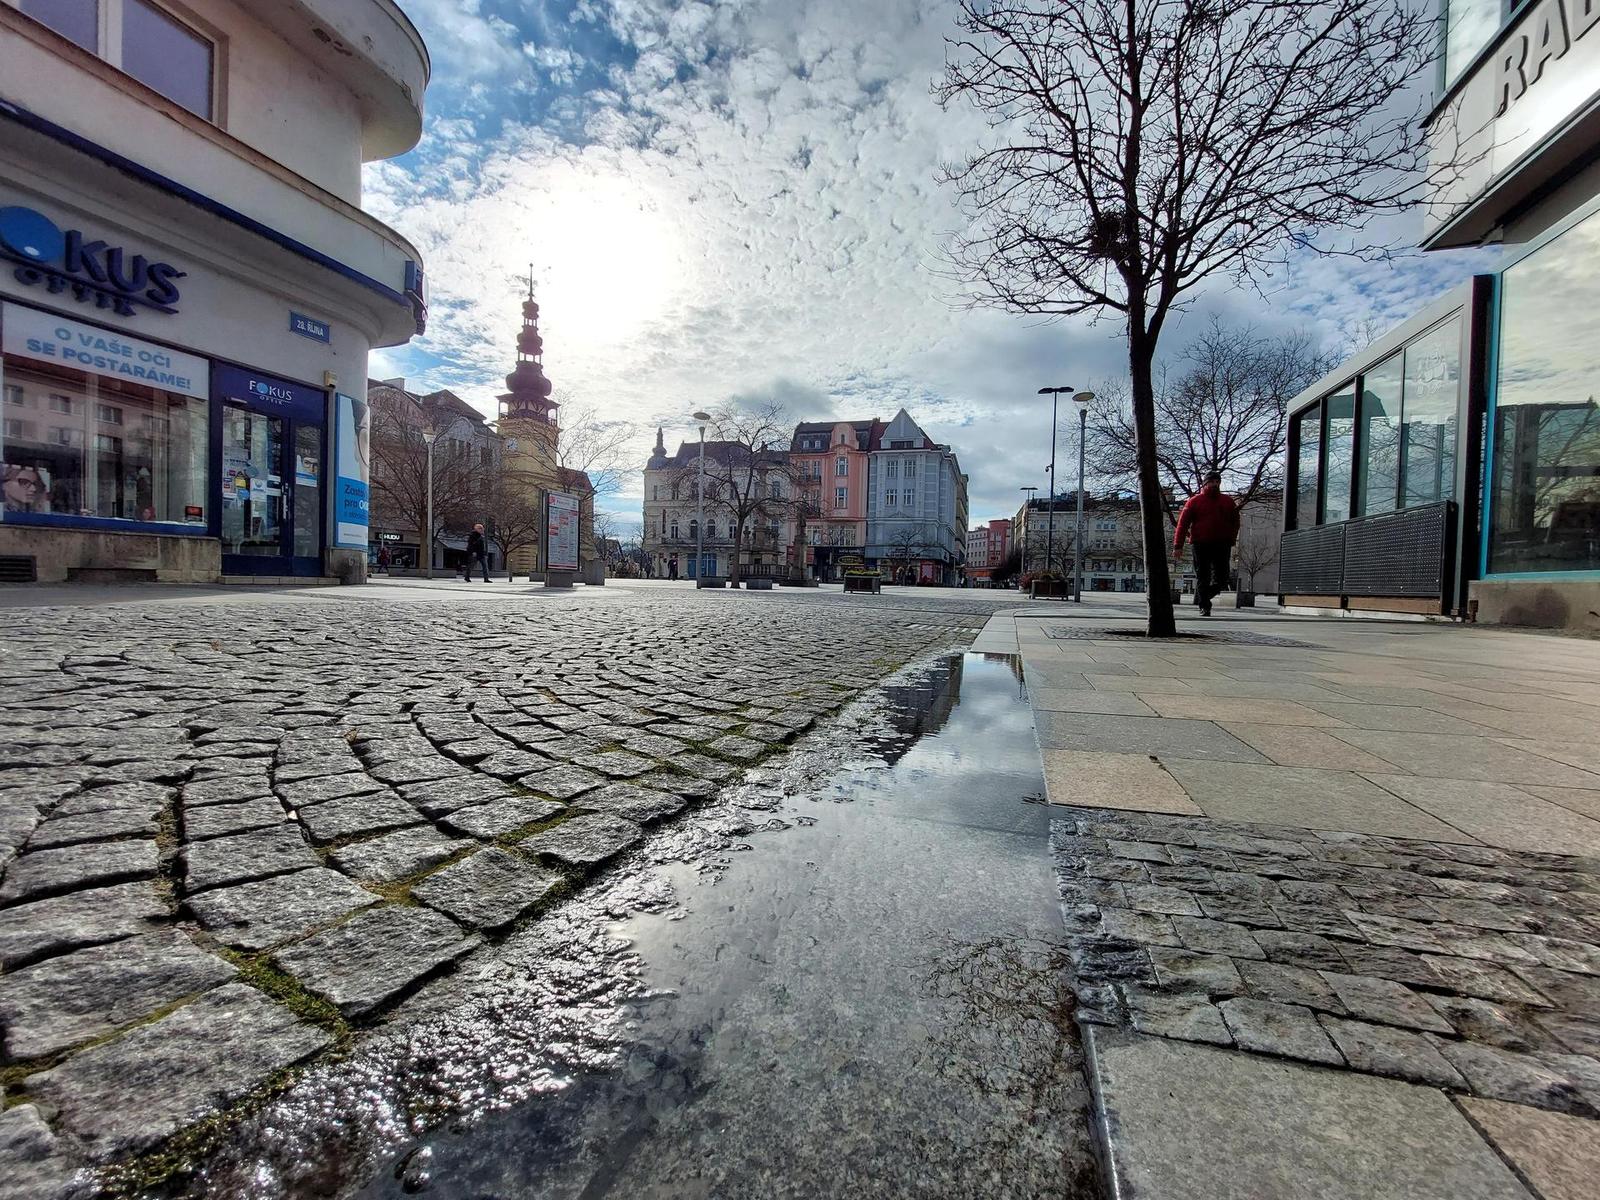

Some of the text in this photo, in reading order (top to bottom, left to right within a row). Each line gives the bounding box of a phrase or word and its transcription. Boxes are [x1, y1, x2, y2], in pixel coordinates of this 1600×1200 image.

[26, 338, 191, 390] SE POSTARÁME!
[54, 327, 170, 369] O VAŠE OČI
[249, 380, 292, 401] FOKUS
